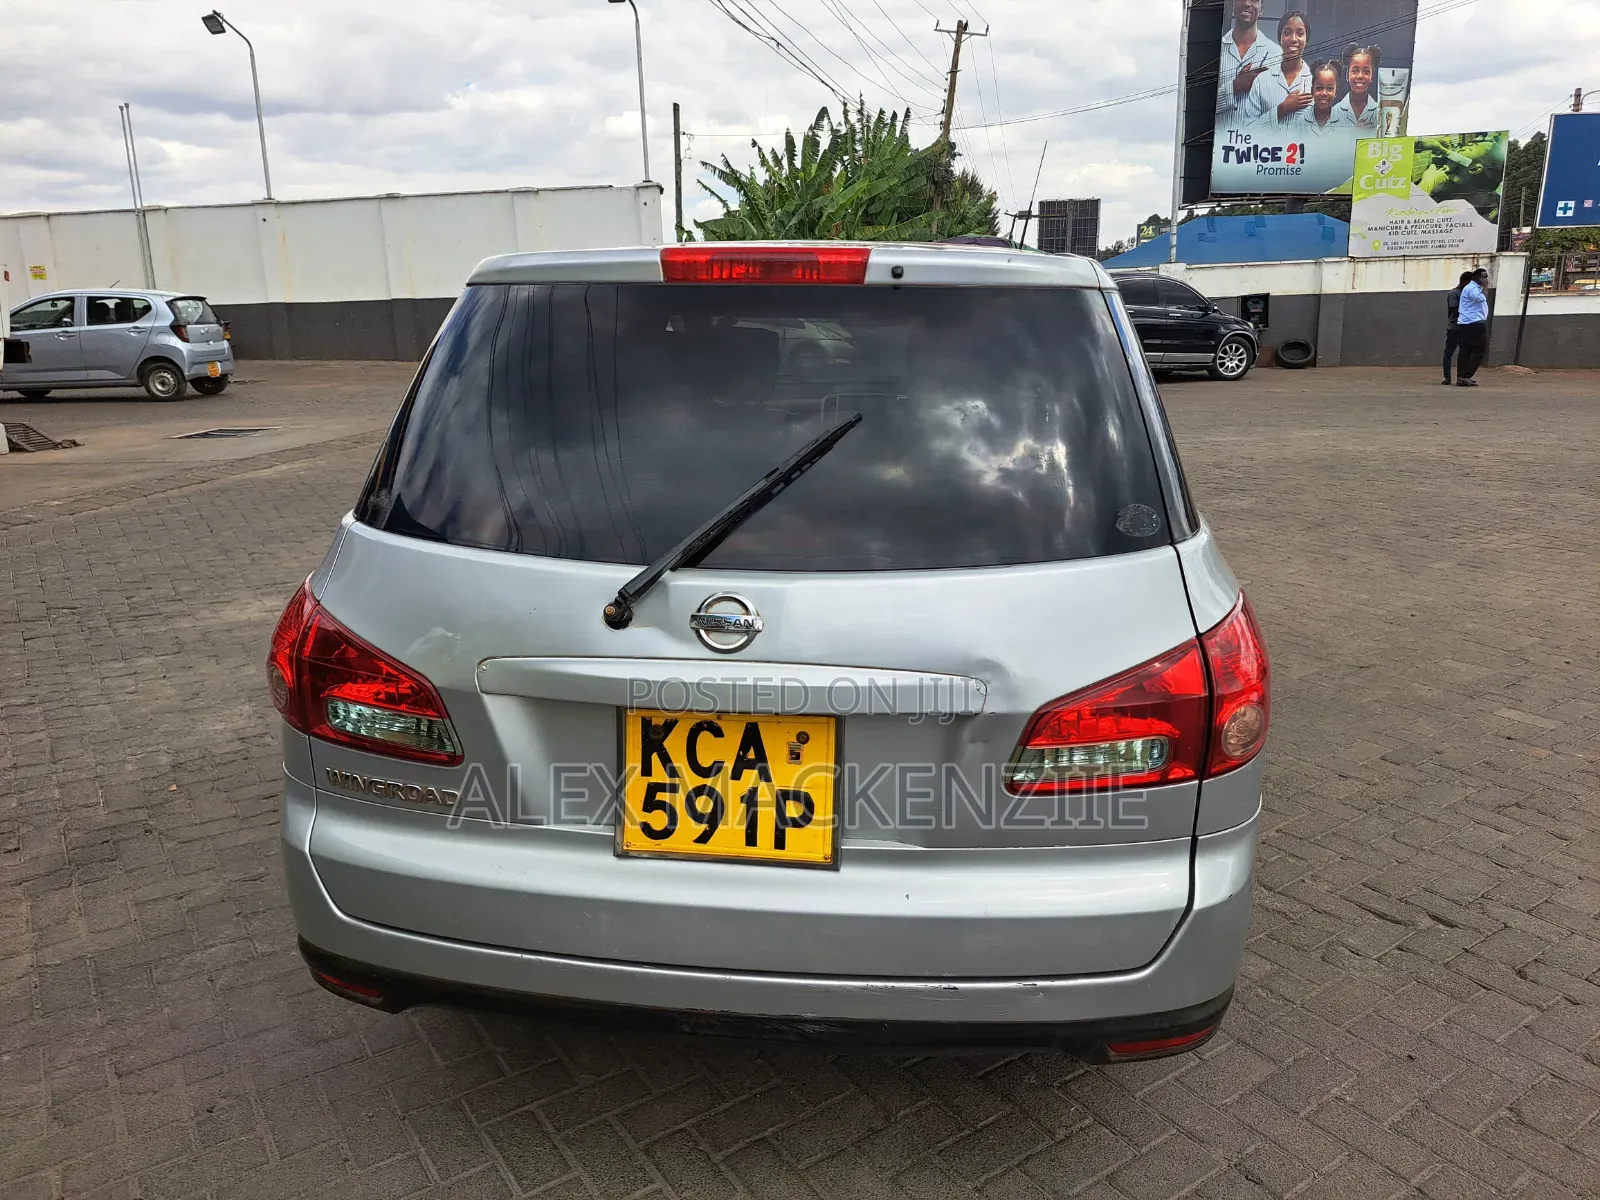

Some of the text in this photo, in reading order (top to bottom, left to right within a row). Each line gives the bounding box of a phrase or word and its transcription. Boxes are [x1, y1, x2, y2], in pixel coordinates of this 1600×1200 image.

[1227, 129, 1252, 144] The
[1367, 140, 1403, 162] Big
[1256, 164, 1302, 176] Promise
[1359, 174, 1406, 190] Cutz
[697, 617, 755, 629] NISSAN
[640, 716, 773, 783] KCA
[325, 767, 460, 806] WINGROAD
[639, 781, 816, 850] 591P
